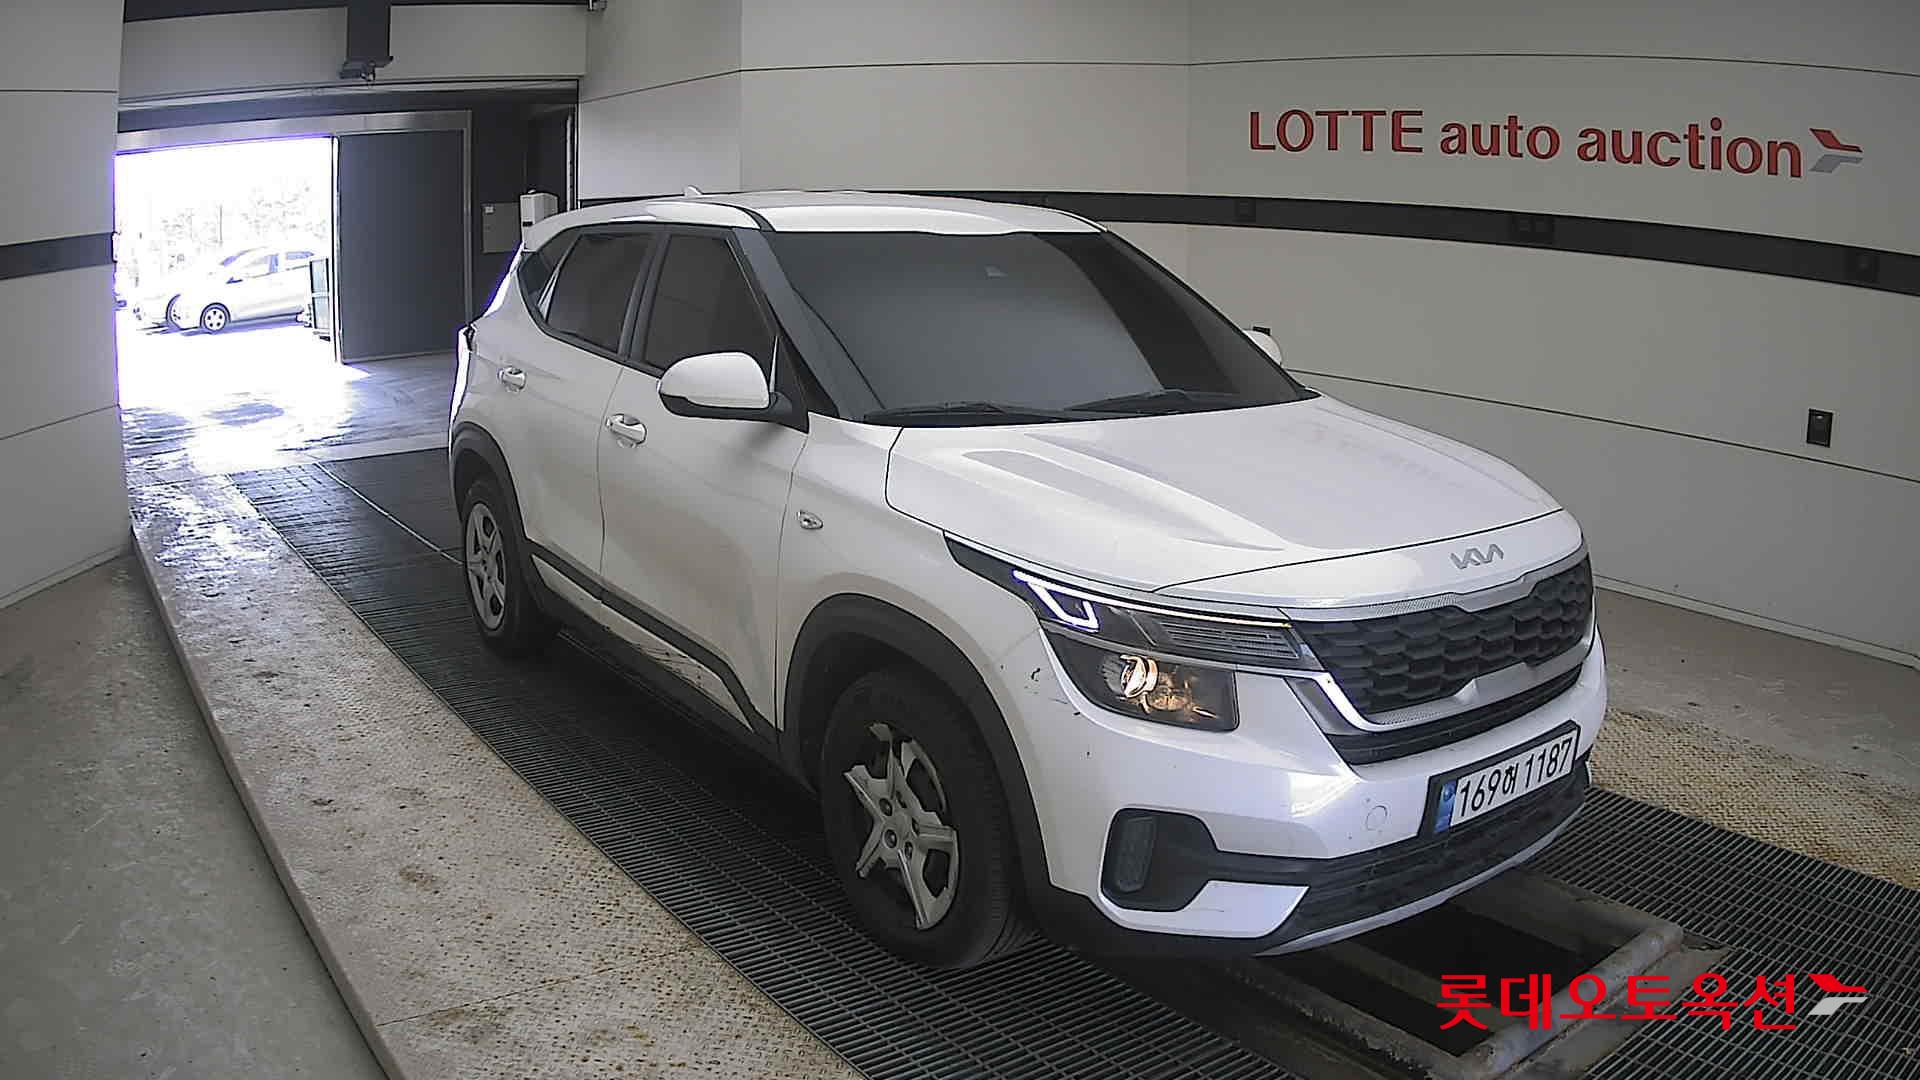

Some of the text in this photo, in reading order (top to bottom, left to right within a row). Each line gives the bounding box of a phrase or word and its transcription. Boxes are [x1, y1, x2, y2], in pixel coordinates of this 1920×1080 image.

[1250, 109, 1802, 178] LOTTE auto auction
[1525, 737, 1573, 788] 1187
